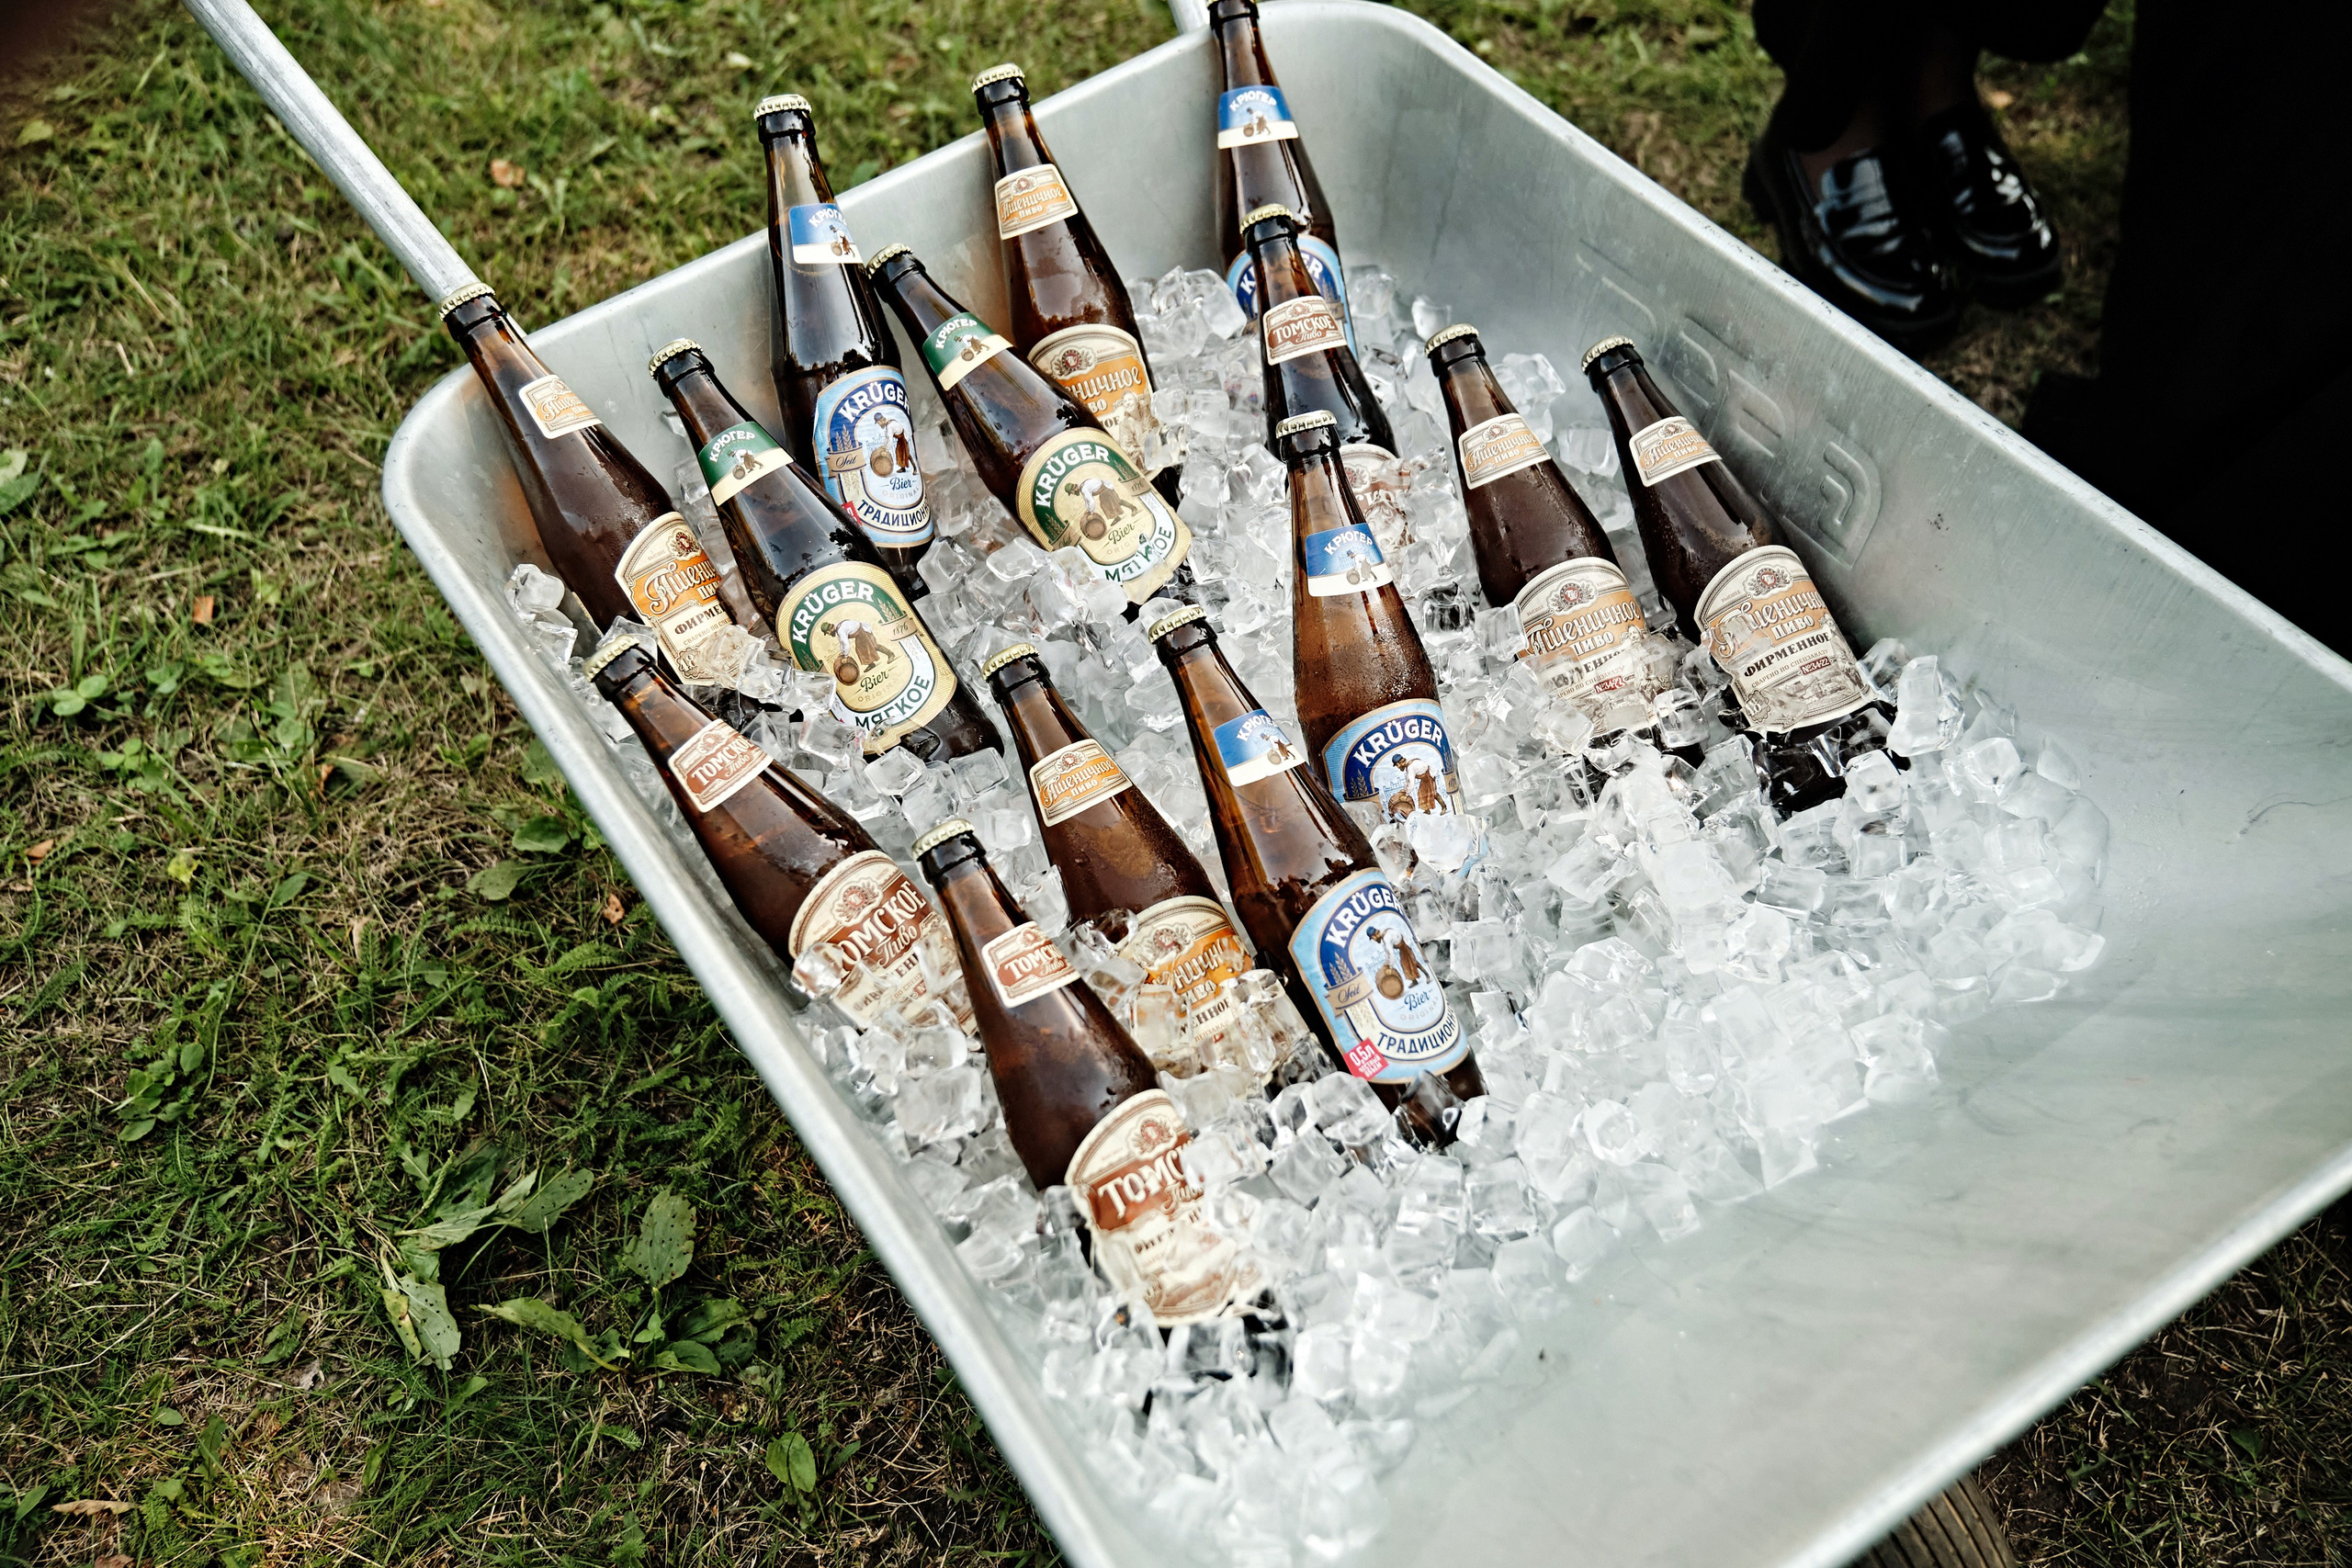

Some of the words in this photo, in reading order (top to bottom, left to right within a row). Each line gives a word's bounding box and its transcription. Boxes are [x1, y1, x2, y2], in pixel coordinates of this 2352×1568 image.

[1229, 90, 1277, 111] КРЮГЕР
[1001, 186, 1063, 222] Пшеничное
[808, 208, 848, 228] КРЮГЕ
[935, 318, 978, 349] КРЮГЕР
[1272, 315, 1336, 344] ТОМСКОЕ
[1295, 329, 1322, 343] Пиво
[1066, 367, 1142, 400] ничное
[1087, 398, 1107, 413] ВО
[709, 430, 756, 463] КРЮГЕР
[835, 454, 858, 468] Seit
[889, 477, 913, 491] Bier
[1035, 444, 1111, 508] KRÜGER
[1108, 523, 1136, 545] Bier
[1323, 530, 1374, 556] КРЮГЕР
[792, 581, 875, 645] KRÜGER
[892, 625, 909, 637] 1876
[1770, 615, 1815, 641] ПИВО
[1569, 630, 1615, 657] ПИВО
[1744, 631, 1830, 678] ФИРМЕННОЕ
[860, 671, 889, 693] Bier
[1751, 670, 1780, 689] СВАРЕНО
[1780, 664, 1790, 673] ПО
[1791, 649, 1829, 668] СПЕЦЗАКАЗУ
[1556, 687, 1575, 698] АРЕНО
[1352, 717, 1443, 769] KRÜGER
[691, 735, 755, 786] ТОМСКОЕ
[724, 752, 751, 777] Пиво
[1043, 760, 1114, 808] Пшеничное
[838, 880, 927, 980] ОМСКОЕ
[876, 924, 919, 967] Пиво
[1338, 984, 1360, 1003] Seit
[1404, 991, 1430, 1011] Bier
[1399, 996, 1440, 1021] ORIGINAL
